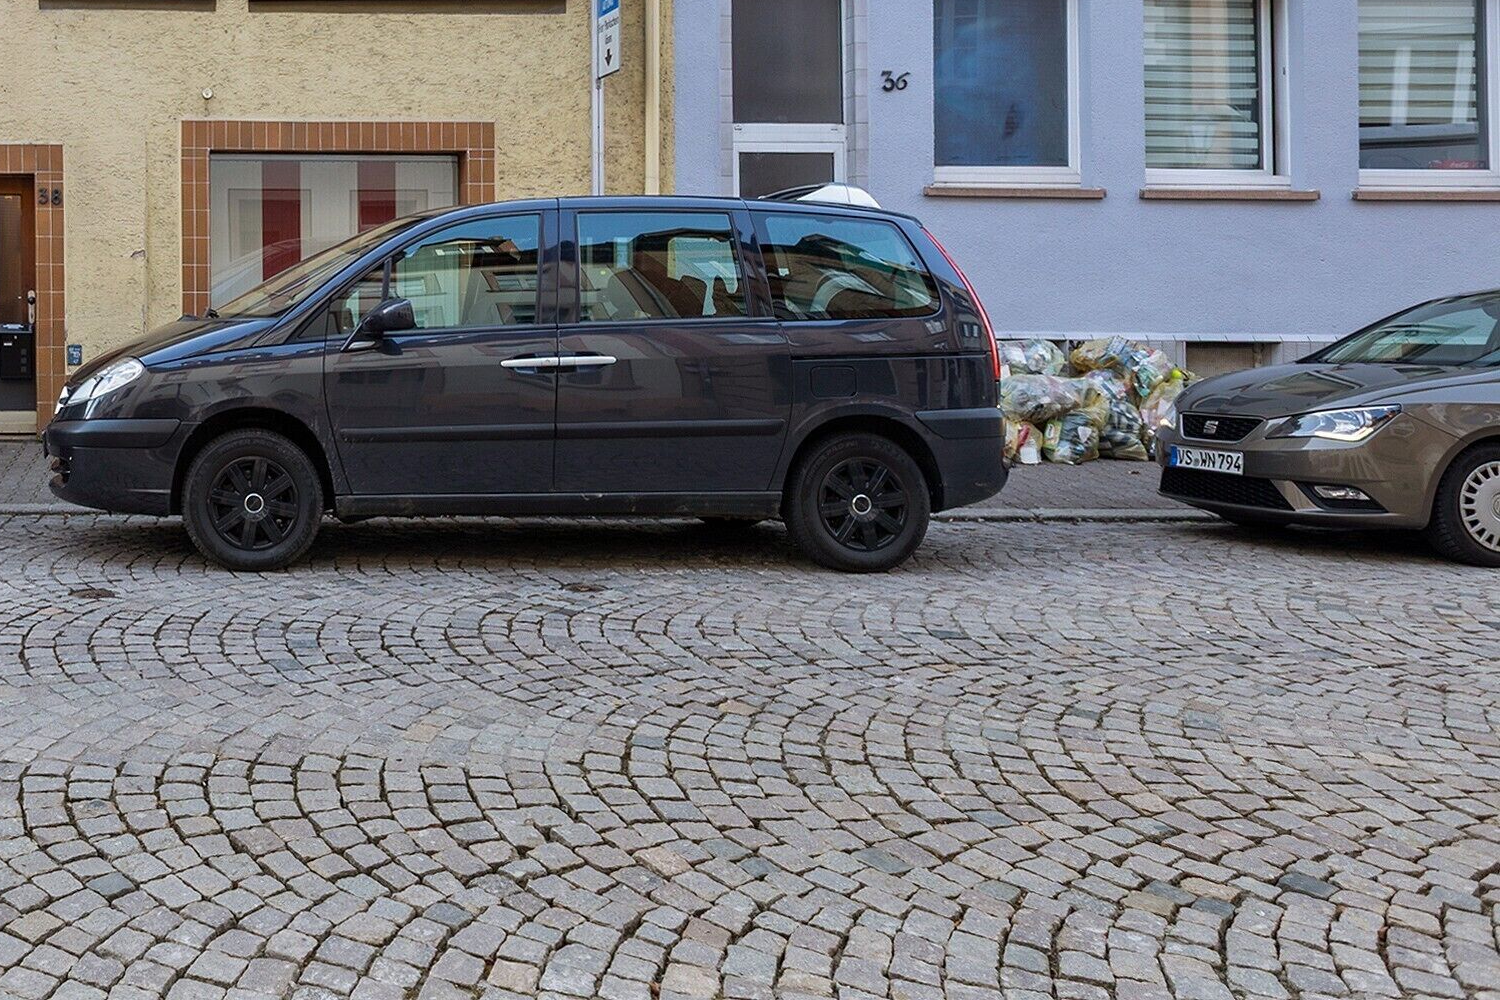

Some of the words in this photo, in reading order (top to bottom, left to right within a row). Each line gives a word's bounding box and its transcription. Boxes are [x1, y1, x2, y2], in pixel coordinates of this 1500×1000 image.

[881, 70, 911, 92] 36
[38, 188, 62, 206] 38
[1177, 449, 1194, 466] VS
[1199, 452, 1216, 469] WN
[1218, 453, 1242, 472] 794
